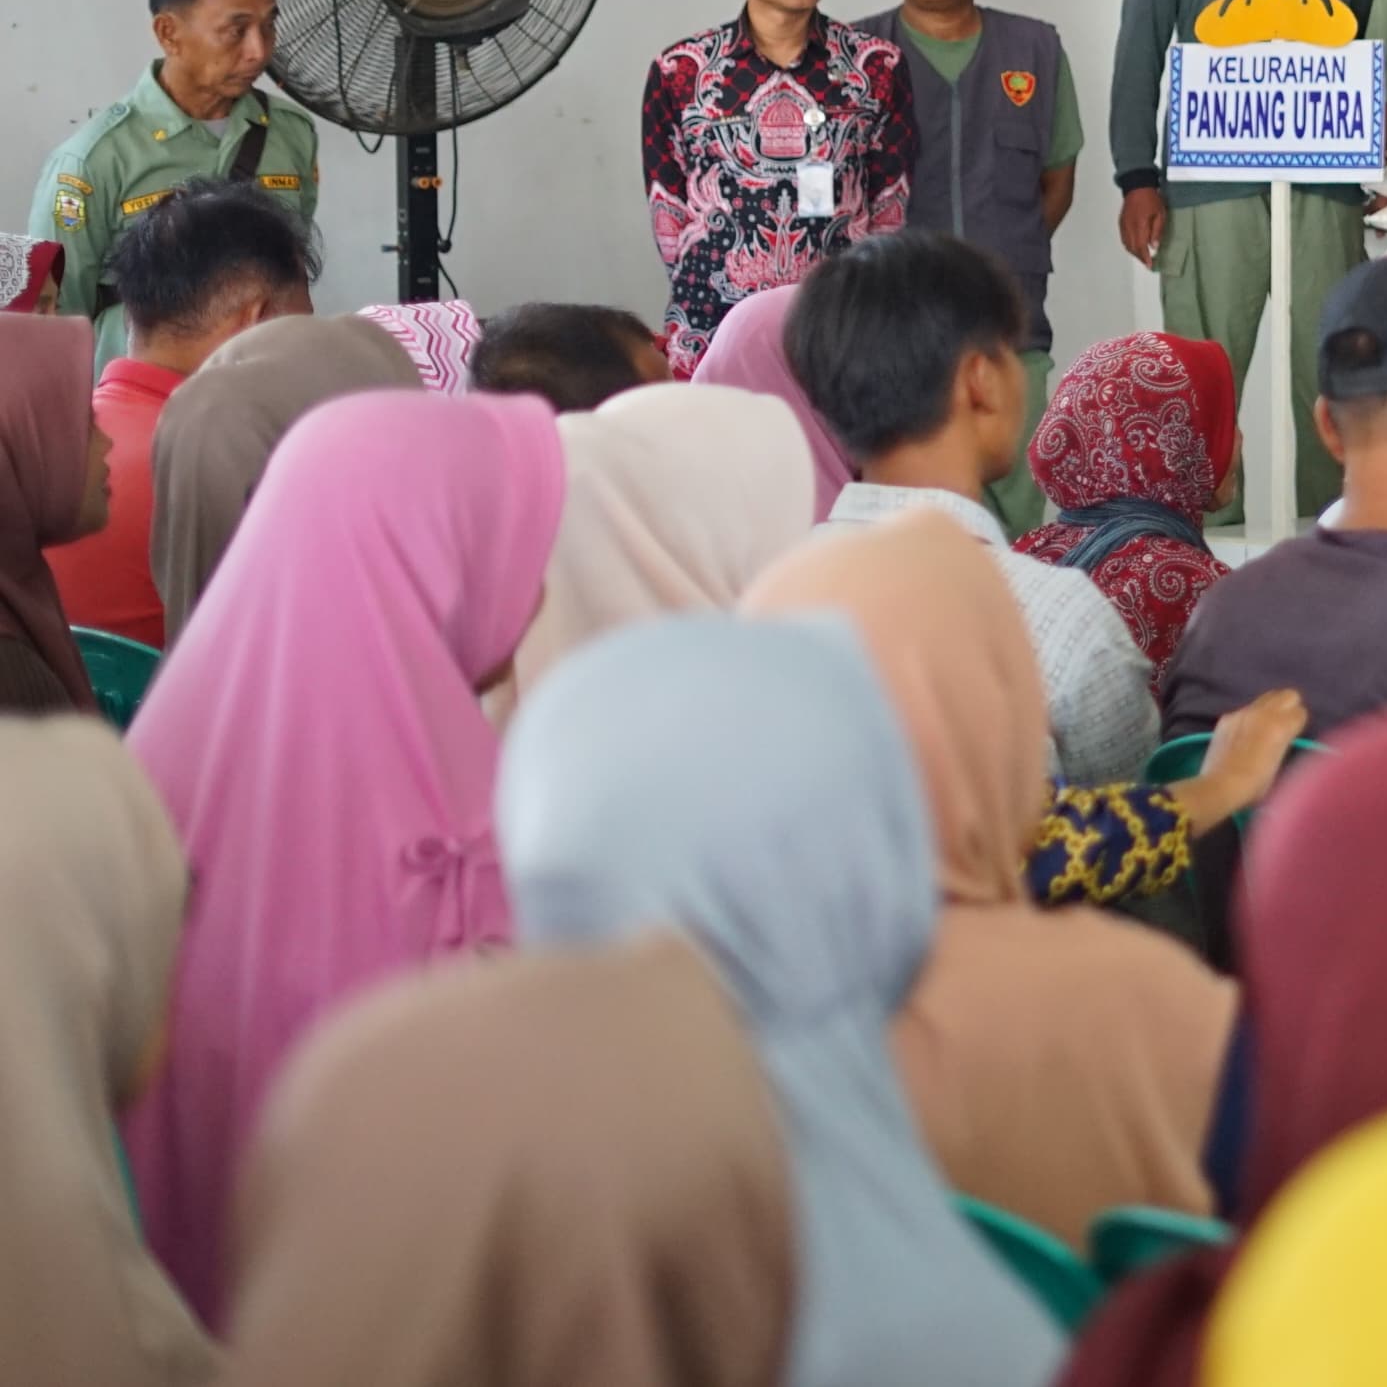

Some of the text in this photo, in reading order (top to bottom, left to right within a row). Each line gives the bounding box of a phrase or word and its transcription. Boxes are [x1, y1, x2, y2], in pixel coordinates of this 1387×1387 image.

[1208, 56, 1346, 84] KELURAHAN
[1186, 90, 1365, 140] PANJANG UTARA
